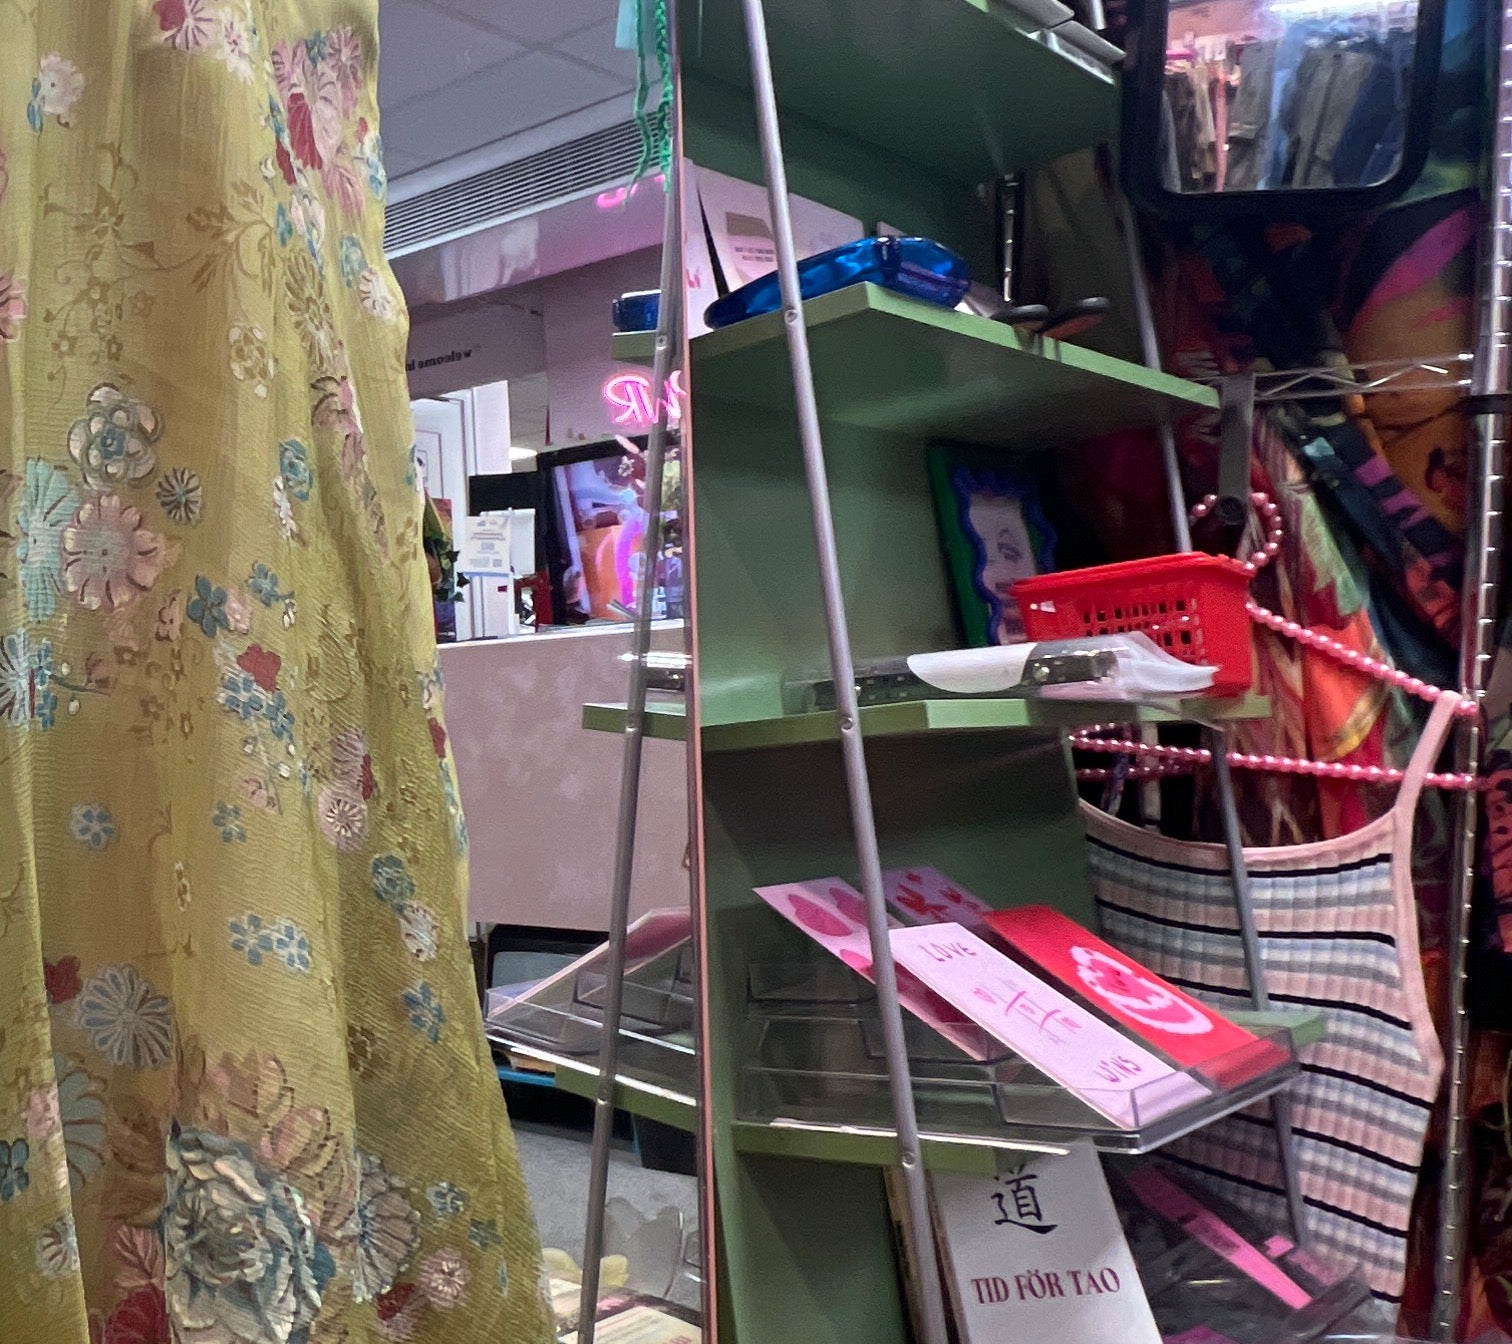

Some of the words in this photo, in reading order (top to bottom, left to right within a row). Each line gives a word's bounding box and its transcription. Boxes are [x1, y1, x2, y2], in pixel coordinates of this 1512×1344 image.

[990, 1165, 1059, 1235] 道
[970, 1276, 1009, 1304] TID
[1014, 1268, 1065, 1301] FÖR
[1067, 1267, 1121, 1296] TAO
